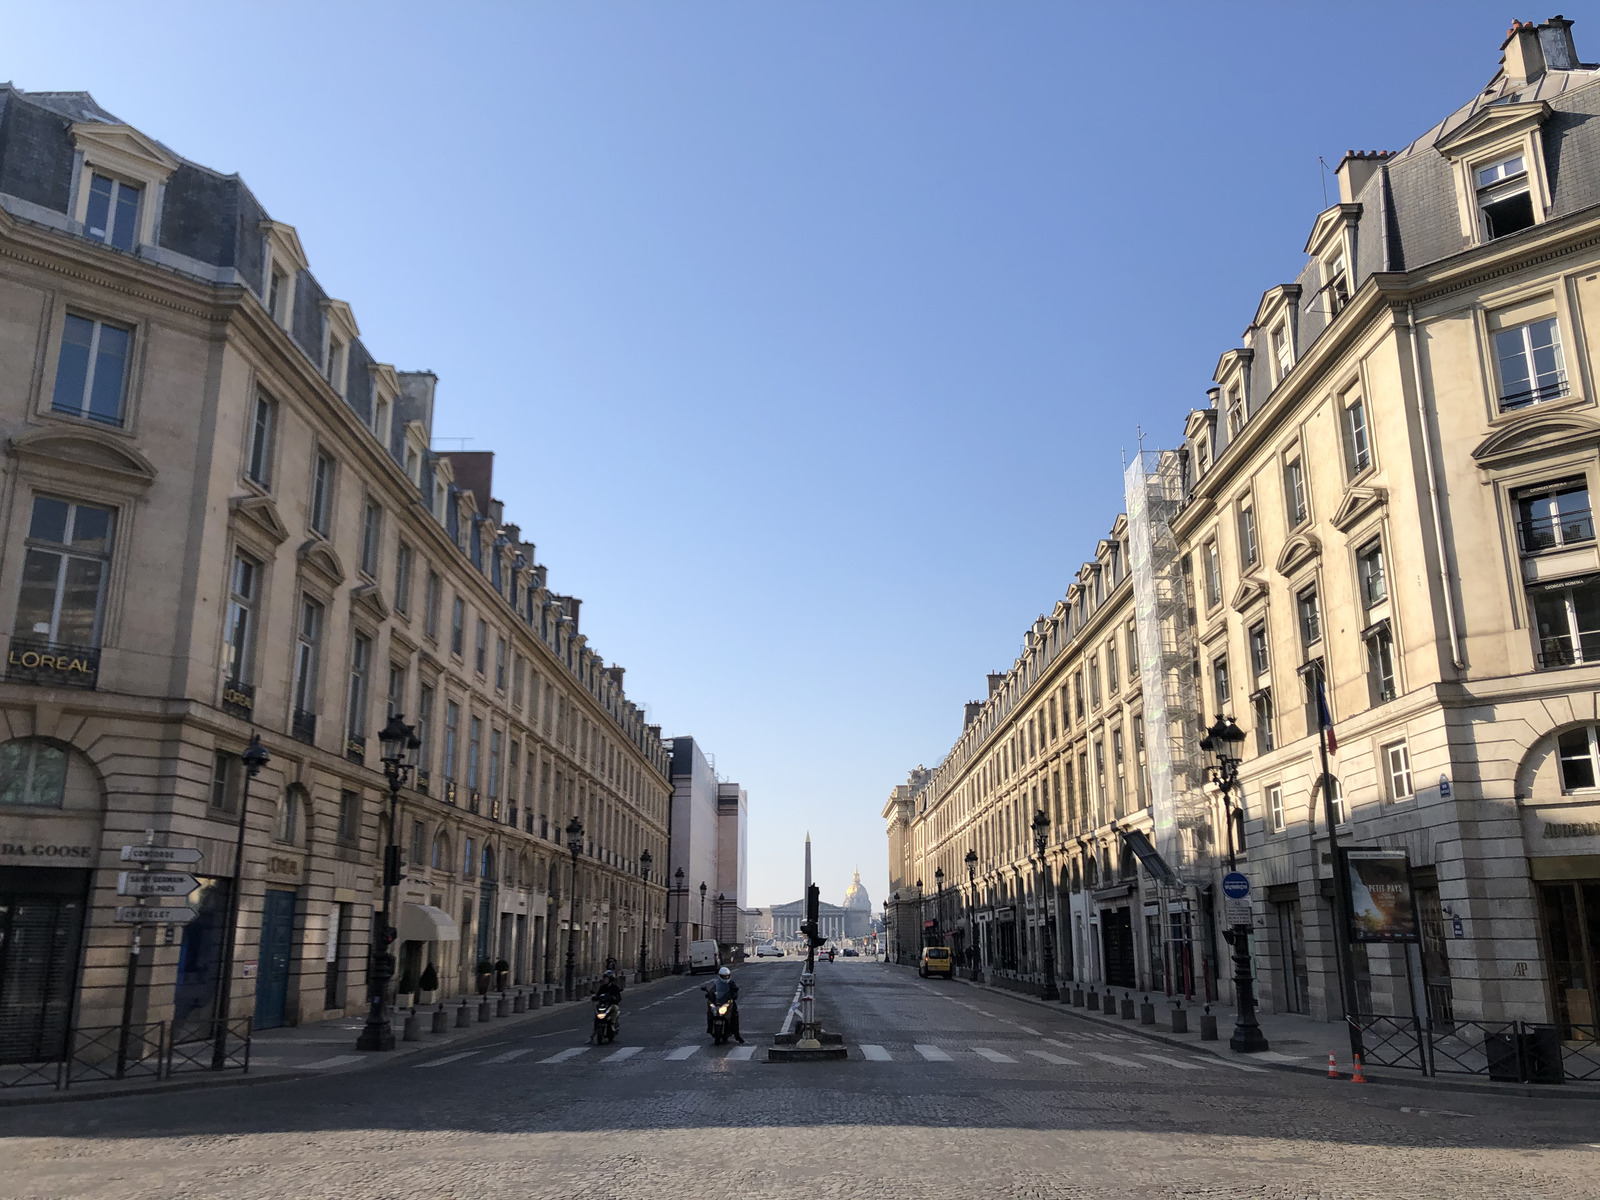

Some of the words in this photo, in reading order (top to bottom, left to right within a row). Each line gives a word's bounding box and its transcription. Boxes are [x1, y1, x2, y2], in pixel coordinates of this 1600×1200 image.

[32, 844, 91, 858] GOOSE
[1369, 885, 1385, 893] PETIT
[1387, 885, 1402, 893] PAYS
